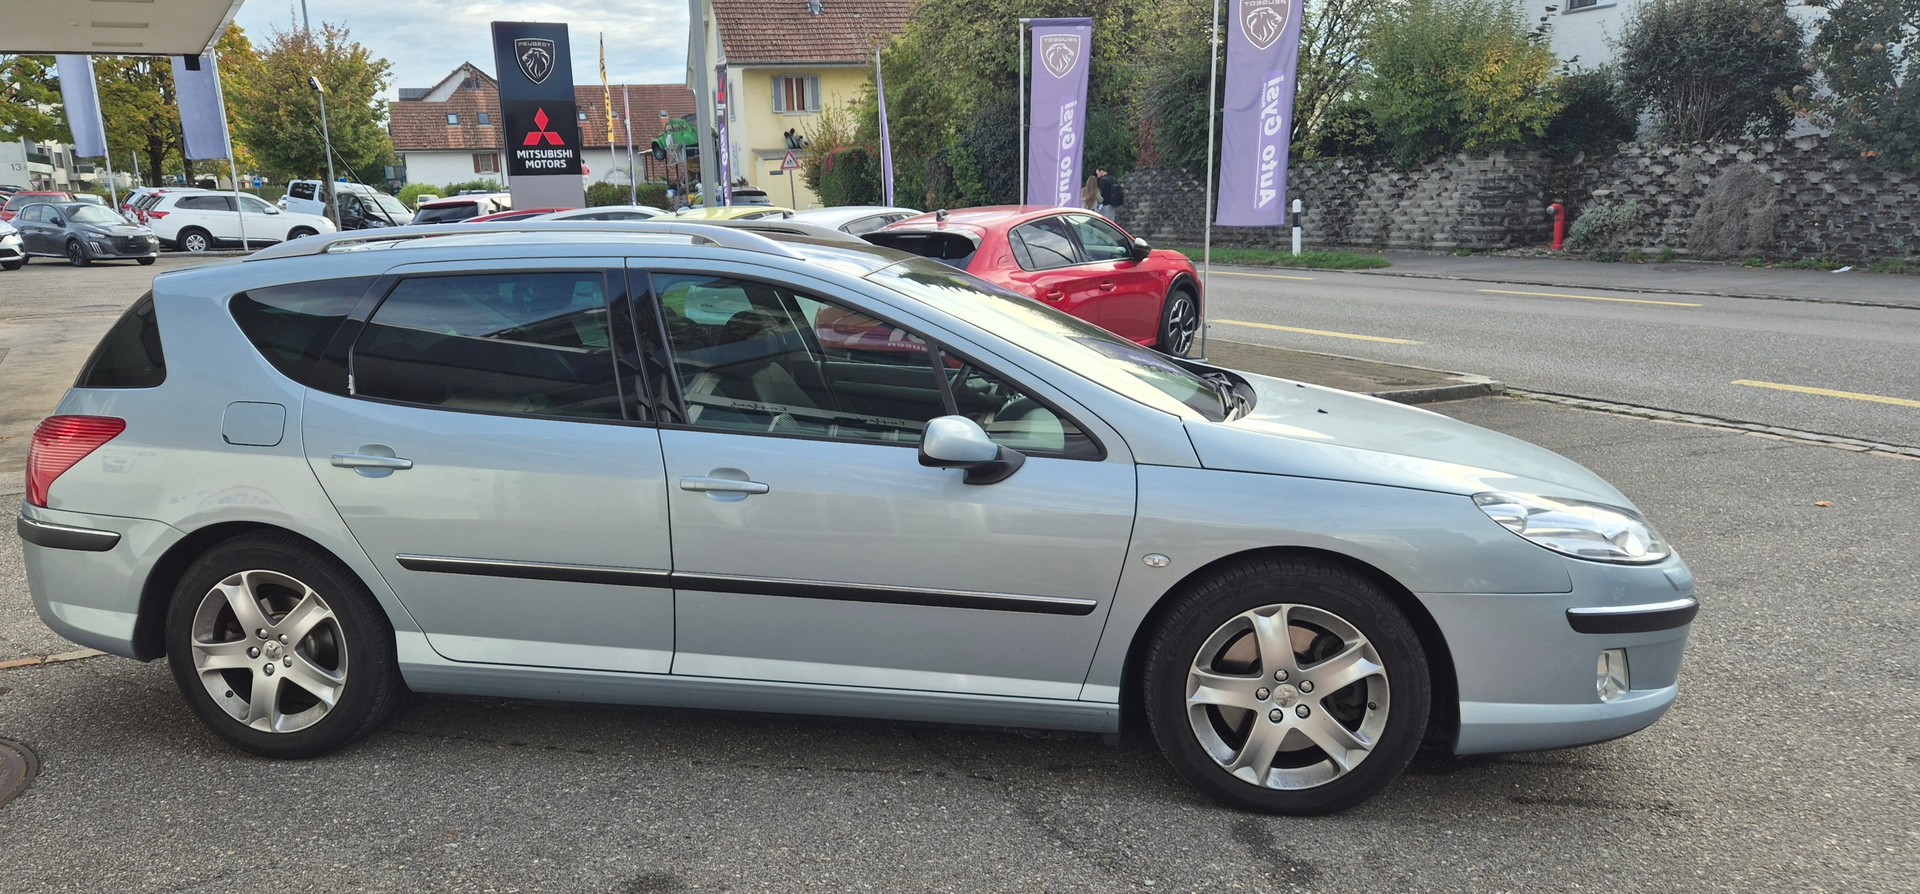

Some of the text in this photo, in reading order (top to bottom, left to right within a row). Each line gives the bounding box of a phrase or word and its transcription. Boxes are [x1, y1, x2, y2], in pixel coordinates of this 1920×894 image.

[516, 149, 573, 159] MITSUBISHI
[10, 163, 22, 171] 13
[525, 159, 567, 169] MOTORS
